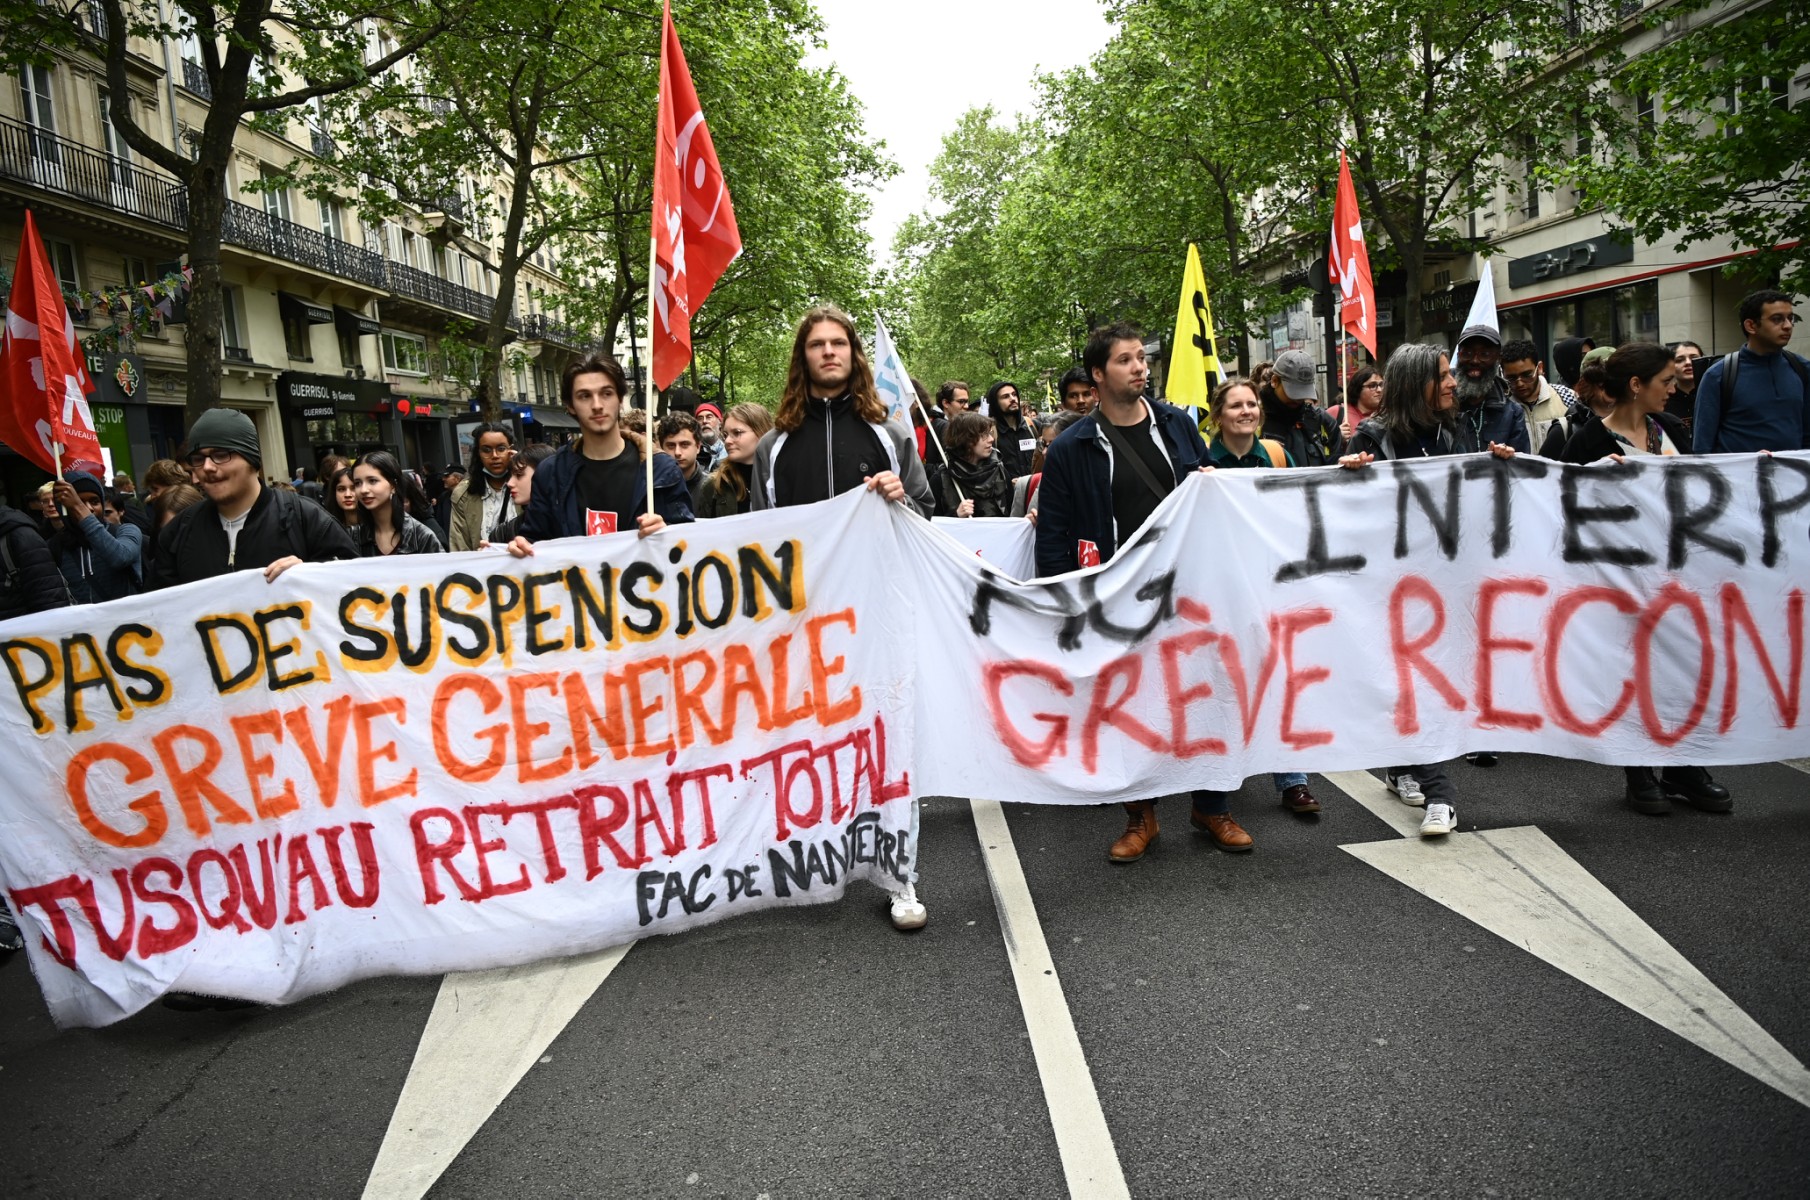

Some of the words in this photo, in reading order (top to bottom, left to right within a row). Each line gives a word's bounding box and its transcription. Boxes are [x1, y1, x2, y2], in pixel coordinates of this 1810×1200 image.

[1532, 243, 1597, 278] BYD
[308, 308, 331, 320] GUERRISOL
[359, 321, 380, 331] GUERRISOL
[290, 383, 330, 399] GUERRISOL
[332, 390, 339, 401] By
[98, 408, 124, 424] STOP
[304, 406, 334, 417] GUERRISOL
[63, 426, 91, 440] OUVEAU
[1253, 455, 1810, 583] INTERP
[1, 623, 173, 734] PAS
[196, 600, 331, 696] DE
[982, 596, 1335, 774] GRÈVE
[1387, 573, 1804, 747] RECON
[66, 694, 418, 848] GREVE
[431, 606, 862, 785] GENERALE
[741, 714, 909, 840] TOTAL
[636, 864, 716, 926] FAC
[725, 865, 762, 902] DE
[767, 811, 910, 897] NANTERRE
